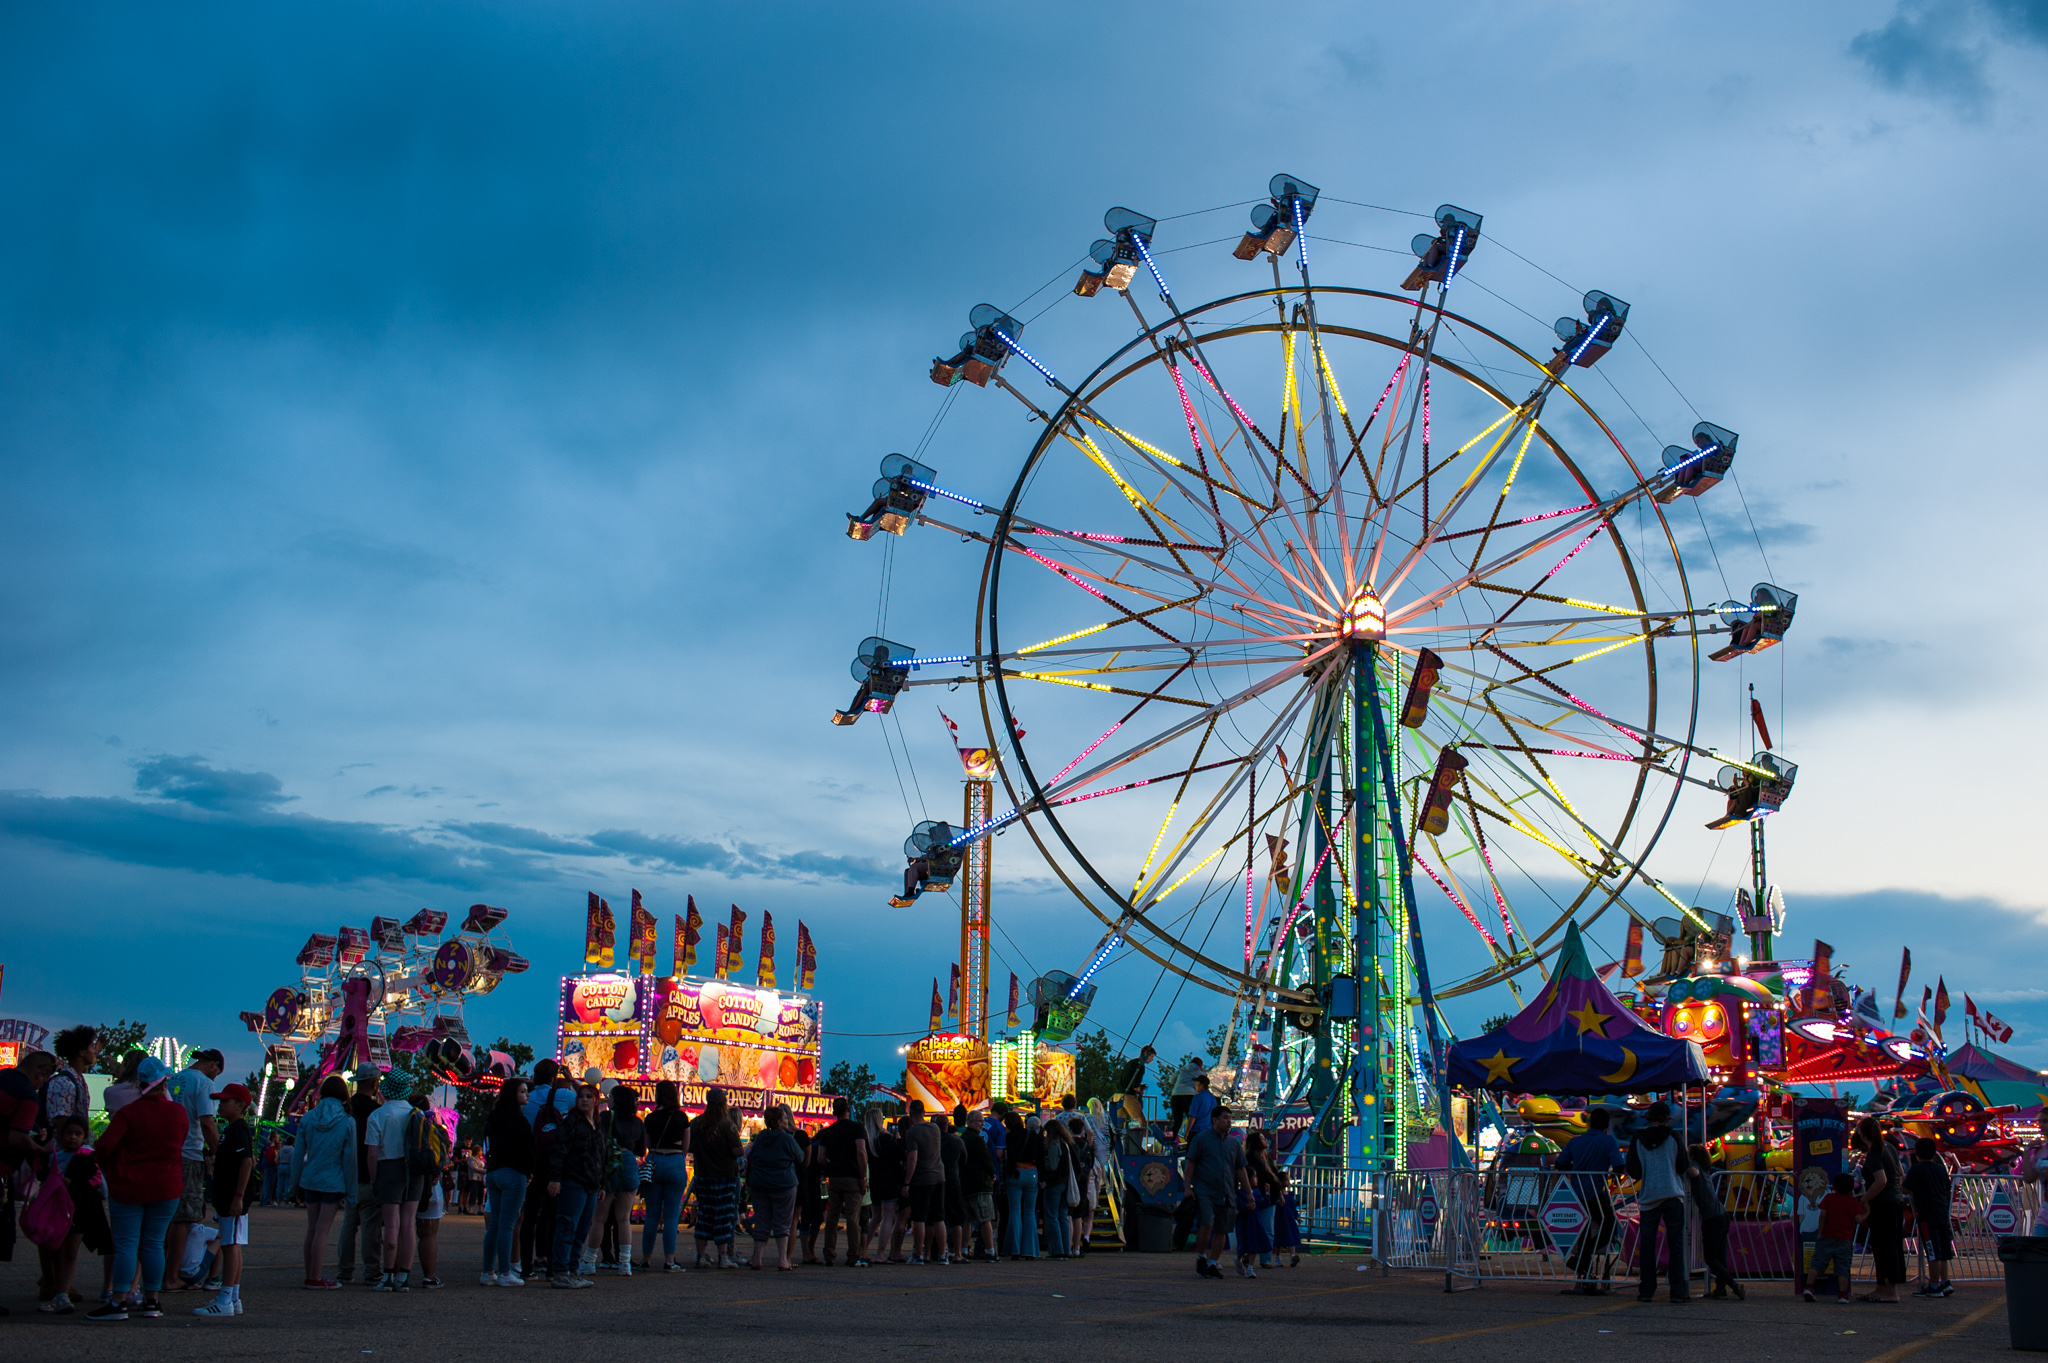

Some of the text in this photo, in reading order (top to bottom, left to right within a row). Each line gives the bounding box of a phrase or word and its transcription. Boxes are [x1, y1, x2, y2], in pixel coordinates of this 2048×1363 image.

[582, 984, 627, 997] COTTON
[585, 997, 623, 1009] CANDY
[669, 990, 699, 1010] CANDY
[718, 995, 763, 1014] COTTON
[666, 1005, 700, 1025] APPLES
[722, 1013, 757, 1029] CANDY
[782, 1007, 798, 1022] SNO
[778, 1022, 805, 1037] KONES
[918, 1036, 975, 1053] RIBBON
[930, 1049, 962, 1062] FRIES
[727, 1090, 762, 1109] ONES
[806, 1097, 834, 1115] APPL
[1797, 1118, 1846, 1131] MINI JETS
[1729, 1153, 1752, 1167] GASOLINE
